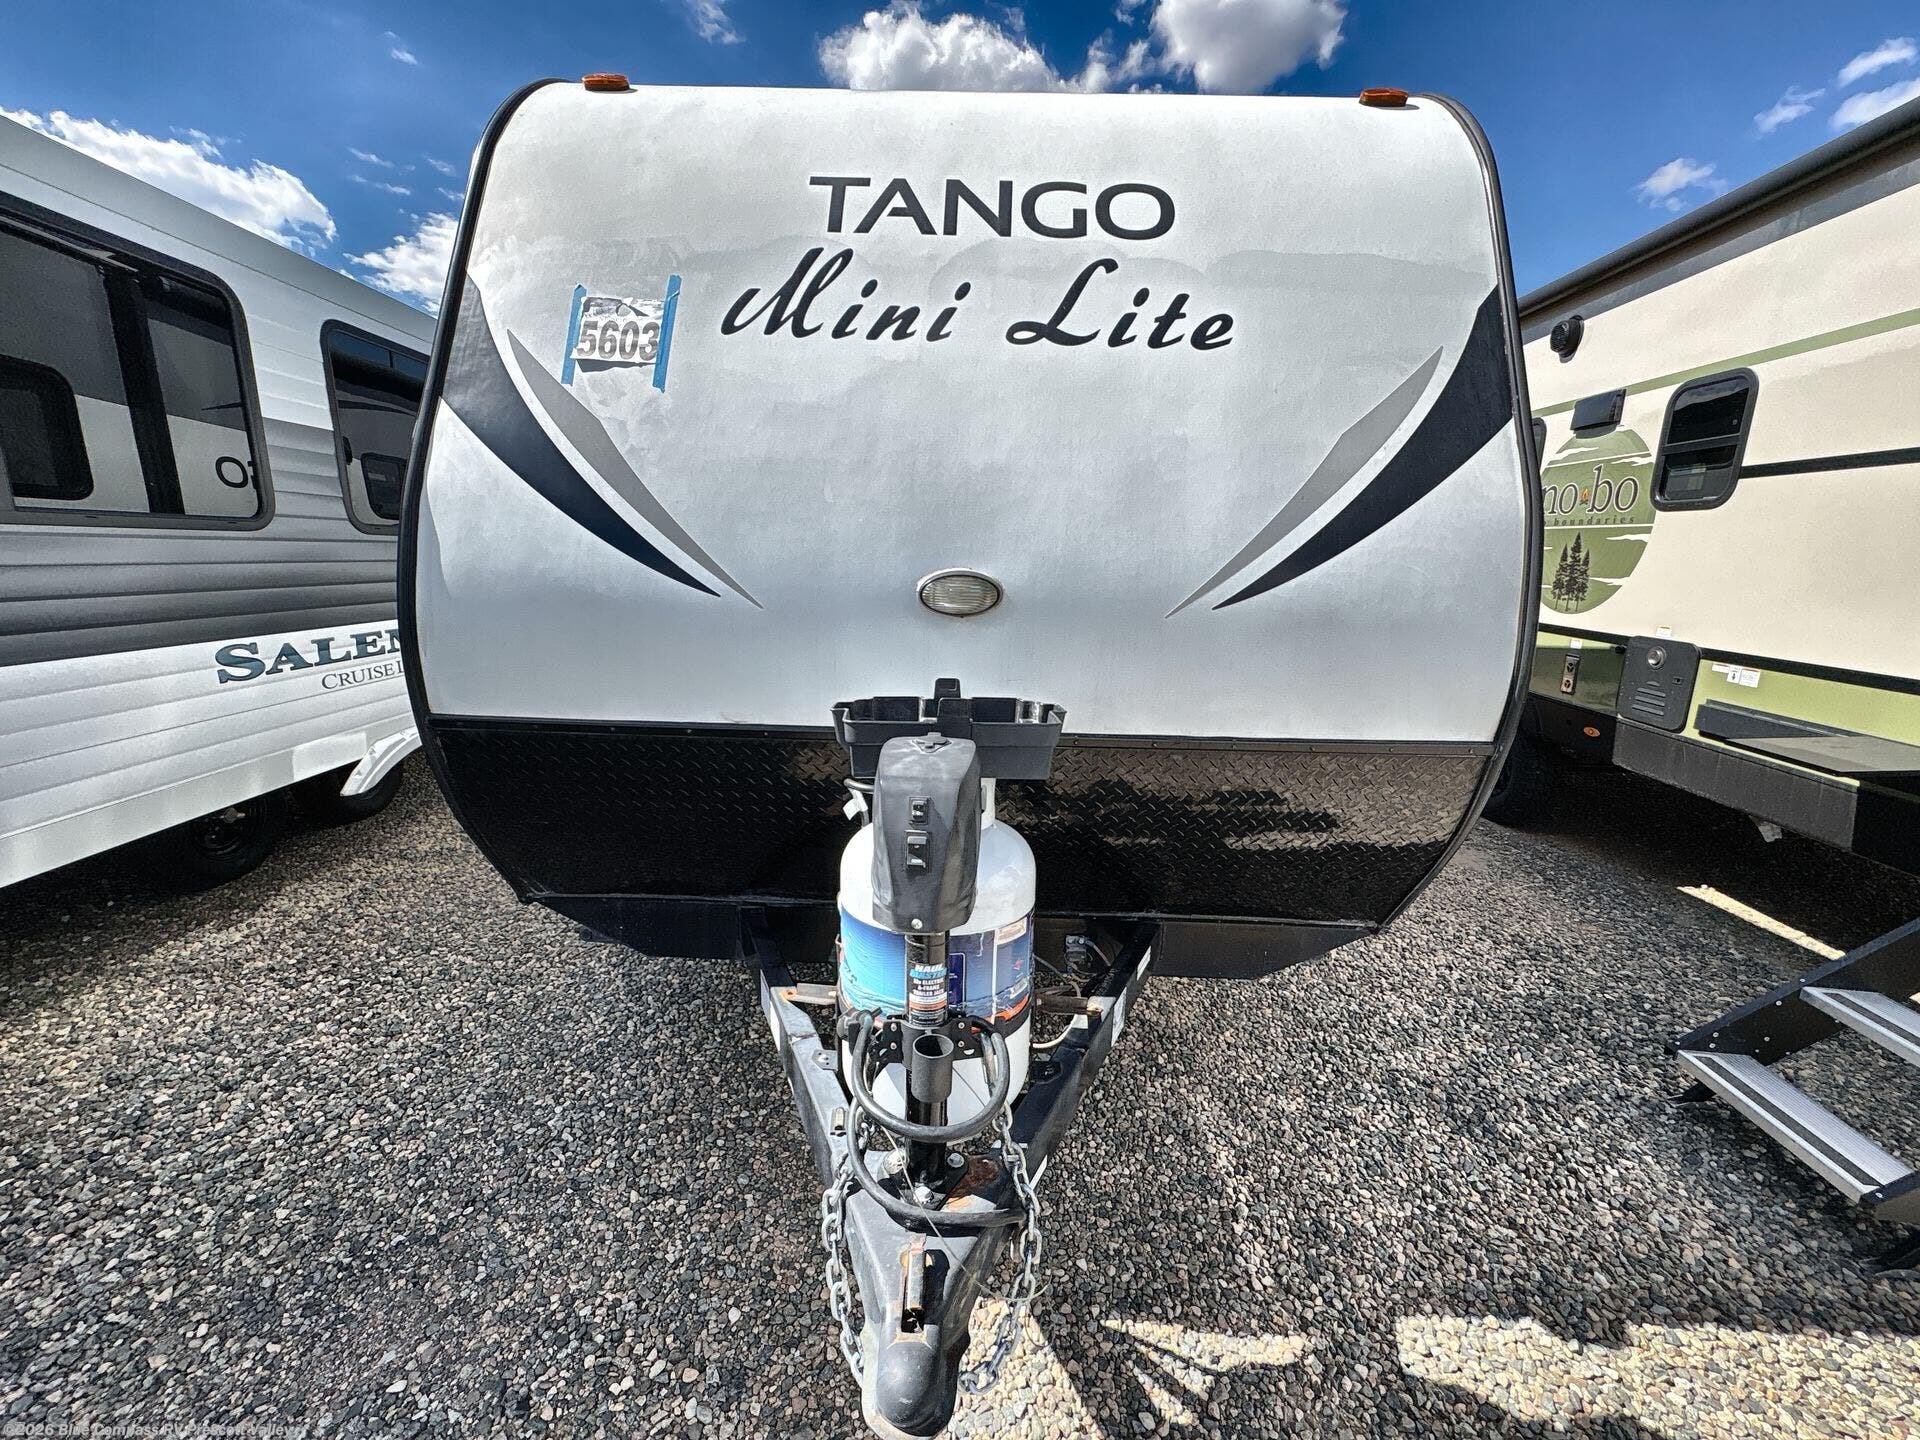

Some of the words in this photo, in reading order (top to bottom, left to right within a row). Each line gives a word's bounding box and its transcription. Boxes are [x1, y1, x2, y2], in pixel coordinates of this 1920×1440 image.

[809, 176, 1175, 240] TANGO
[720, 246, 971, 342] Mini
[1005, 258, 1234, 350] Lite
[577, 320, 660, 361] 5603
[1554, 515, 1635, 527] boundaries
